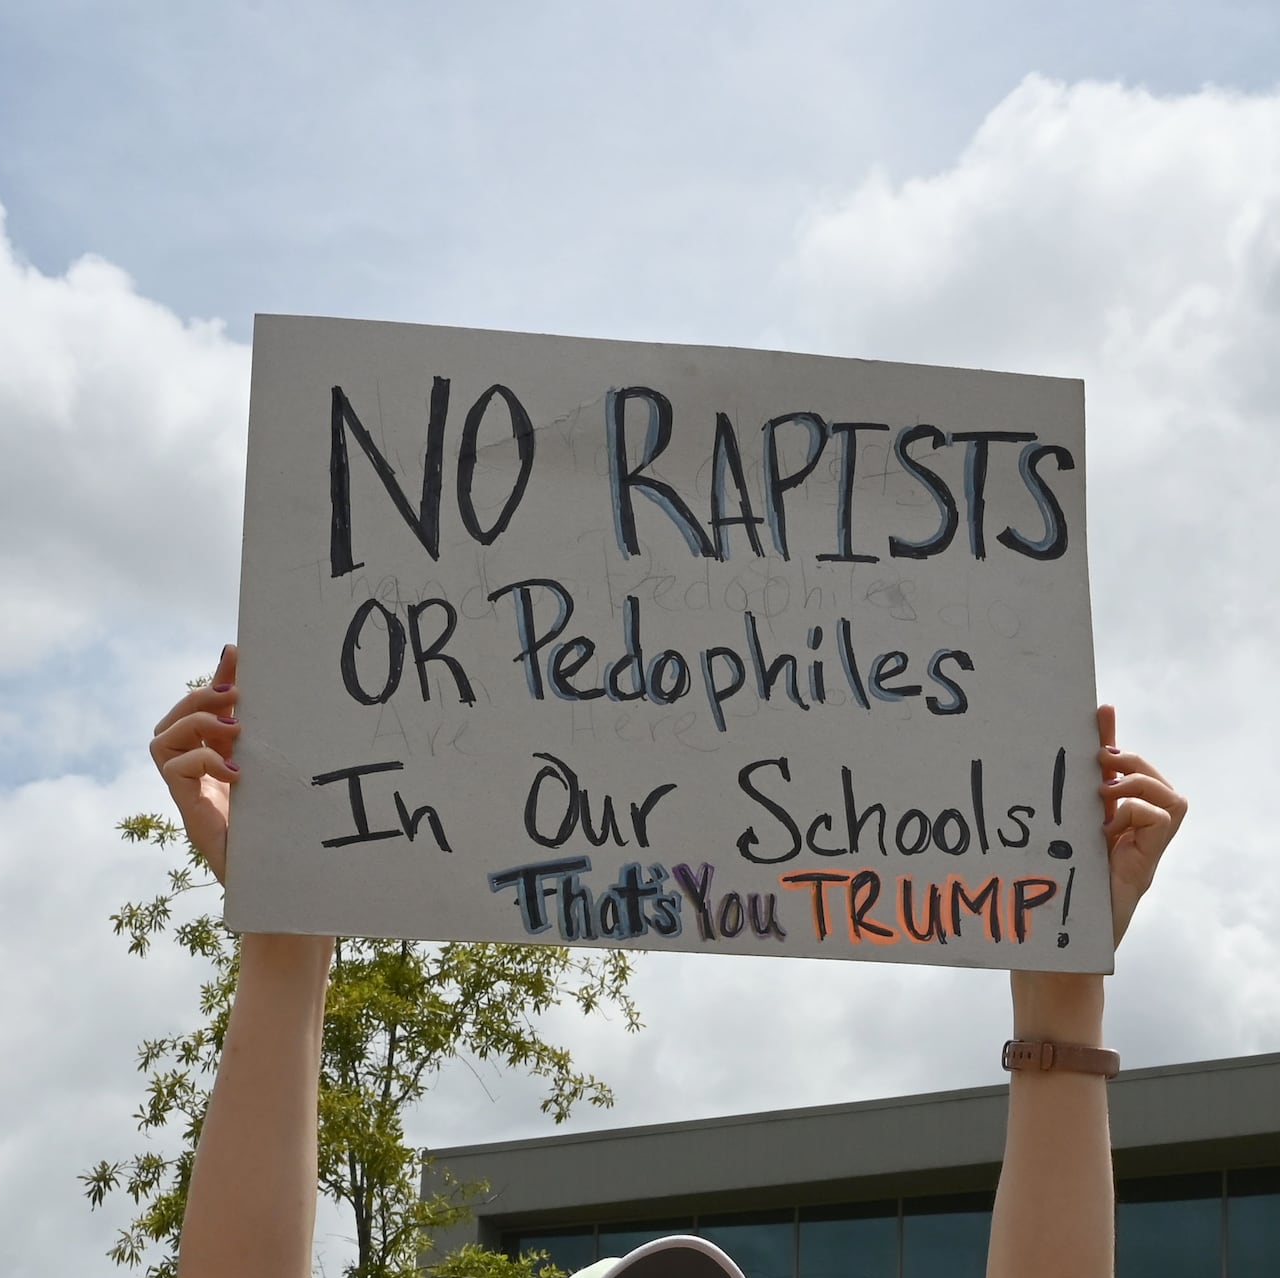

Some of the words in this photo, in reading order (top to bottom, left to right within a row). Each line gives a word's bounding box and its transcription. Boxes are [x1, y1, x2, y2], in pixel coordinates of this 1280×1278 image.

[330, 375, 535, 578] NO
[605, 386, 1076, 562] RAPISTS
[340, 597, 478, 709] OR
[489, 578, 976, 732] Pedophiles
[311, 759, 452, 854] In
[522, 752, 678, 850] Our
[737, 747, 1074, 864] Schools!
[672, 862, 787, 942] You
[781, 867, 1078, 950] TRUMP!
